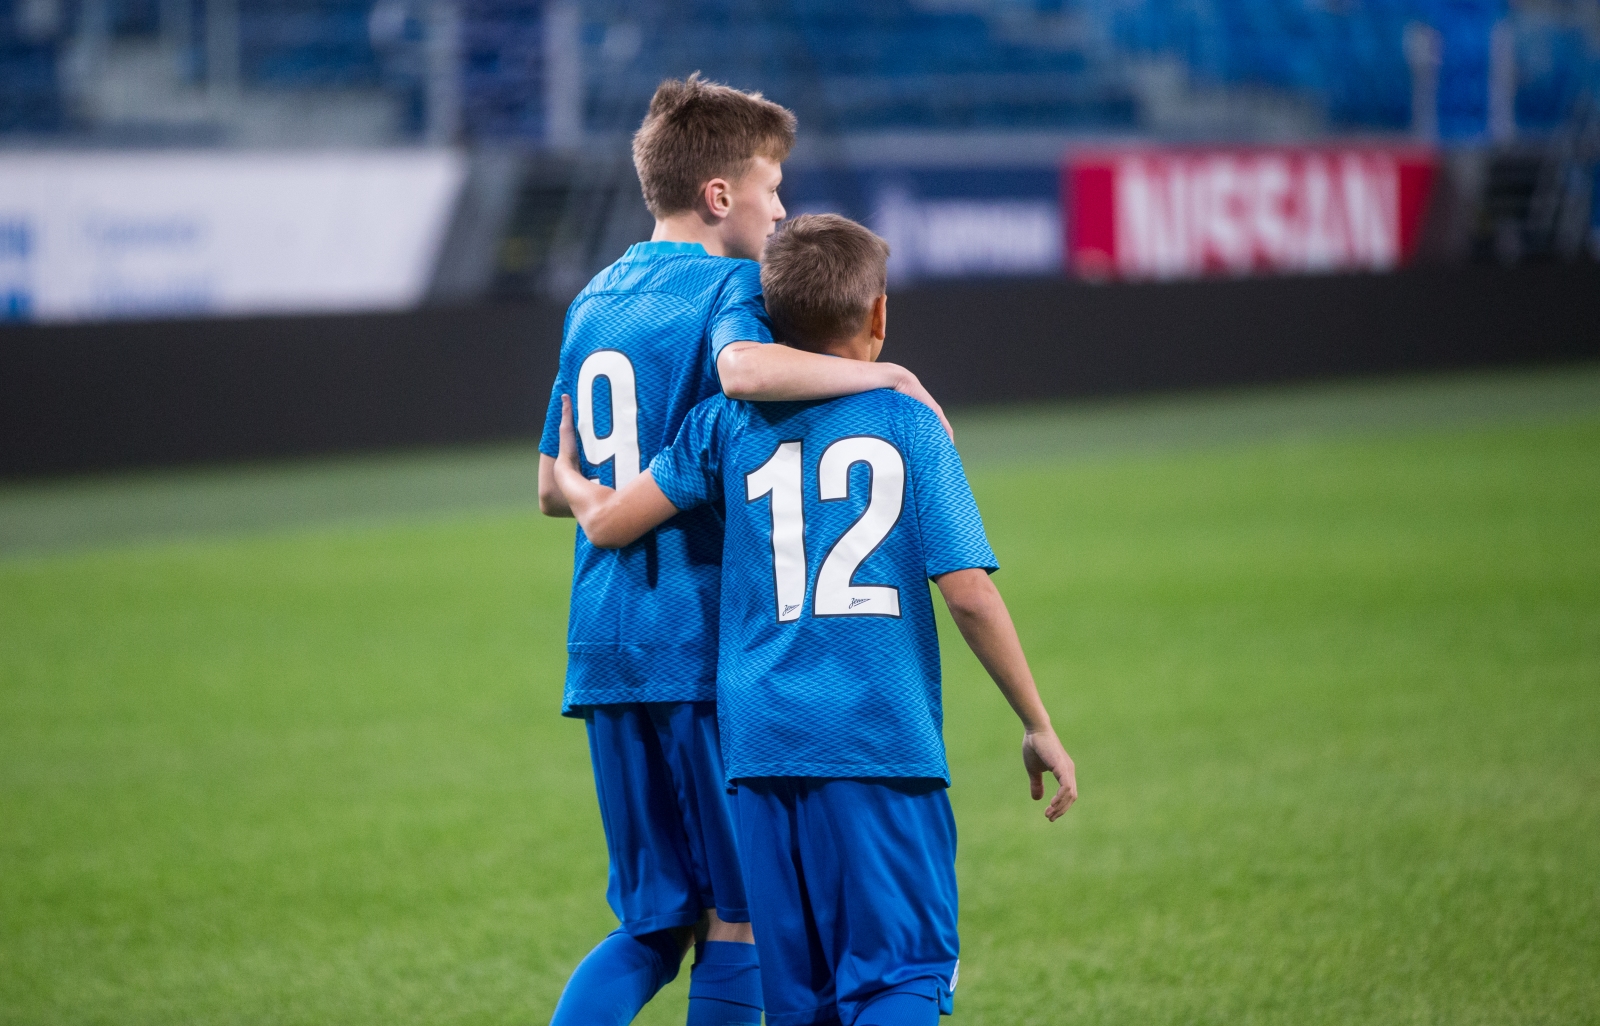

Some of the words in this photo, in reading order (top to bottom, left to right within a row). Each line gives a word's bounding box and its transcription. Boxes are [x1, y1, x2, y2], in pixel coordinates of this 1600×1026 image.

[1114, 153, 1400, 281] NISSAN
[577, 348, 641, 492] 9
[744, 434, 907, 625] 12
